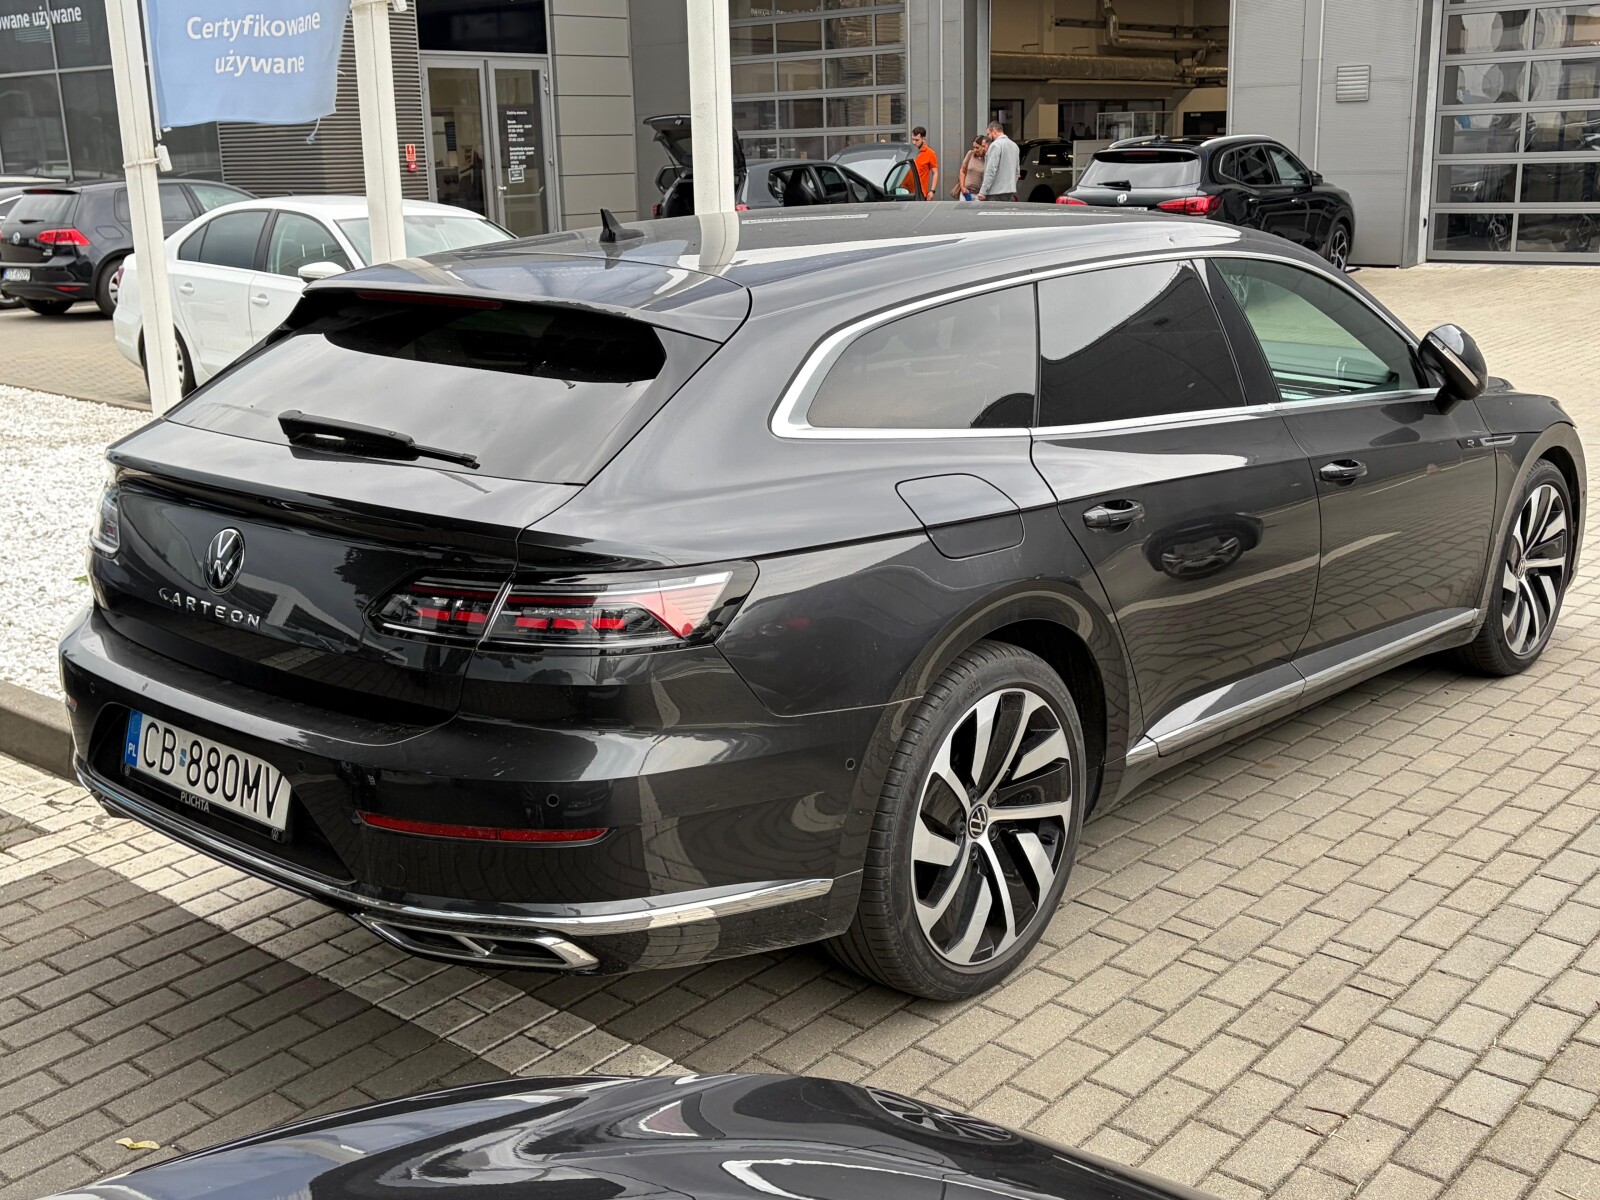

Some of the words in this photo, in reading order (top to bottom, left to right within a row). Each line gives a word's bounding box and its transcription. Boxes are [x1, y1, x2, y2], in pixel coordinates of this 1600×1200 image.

[32, 6, 82, 30] używane
[187, 11, 321, 42] Certyfikowane
[215, 50, 304, 77] używane
[128, 742, 137, 757] PL
[143, 721, 178, 776] CB
[186, 740, 284, 819] 880MV
[180, 792, 210, 813] PLICHTA
